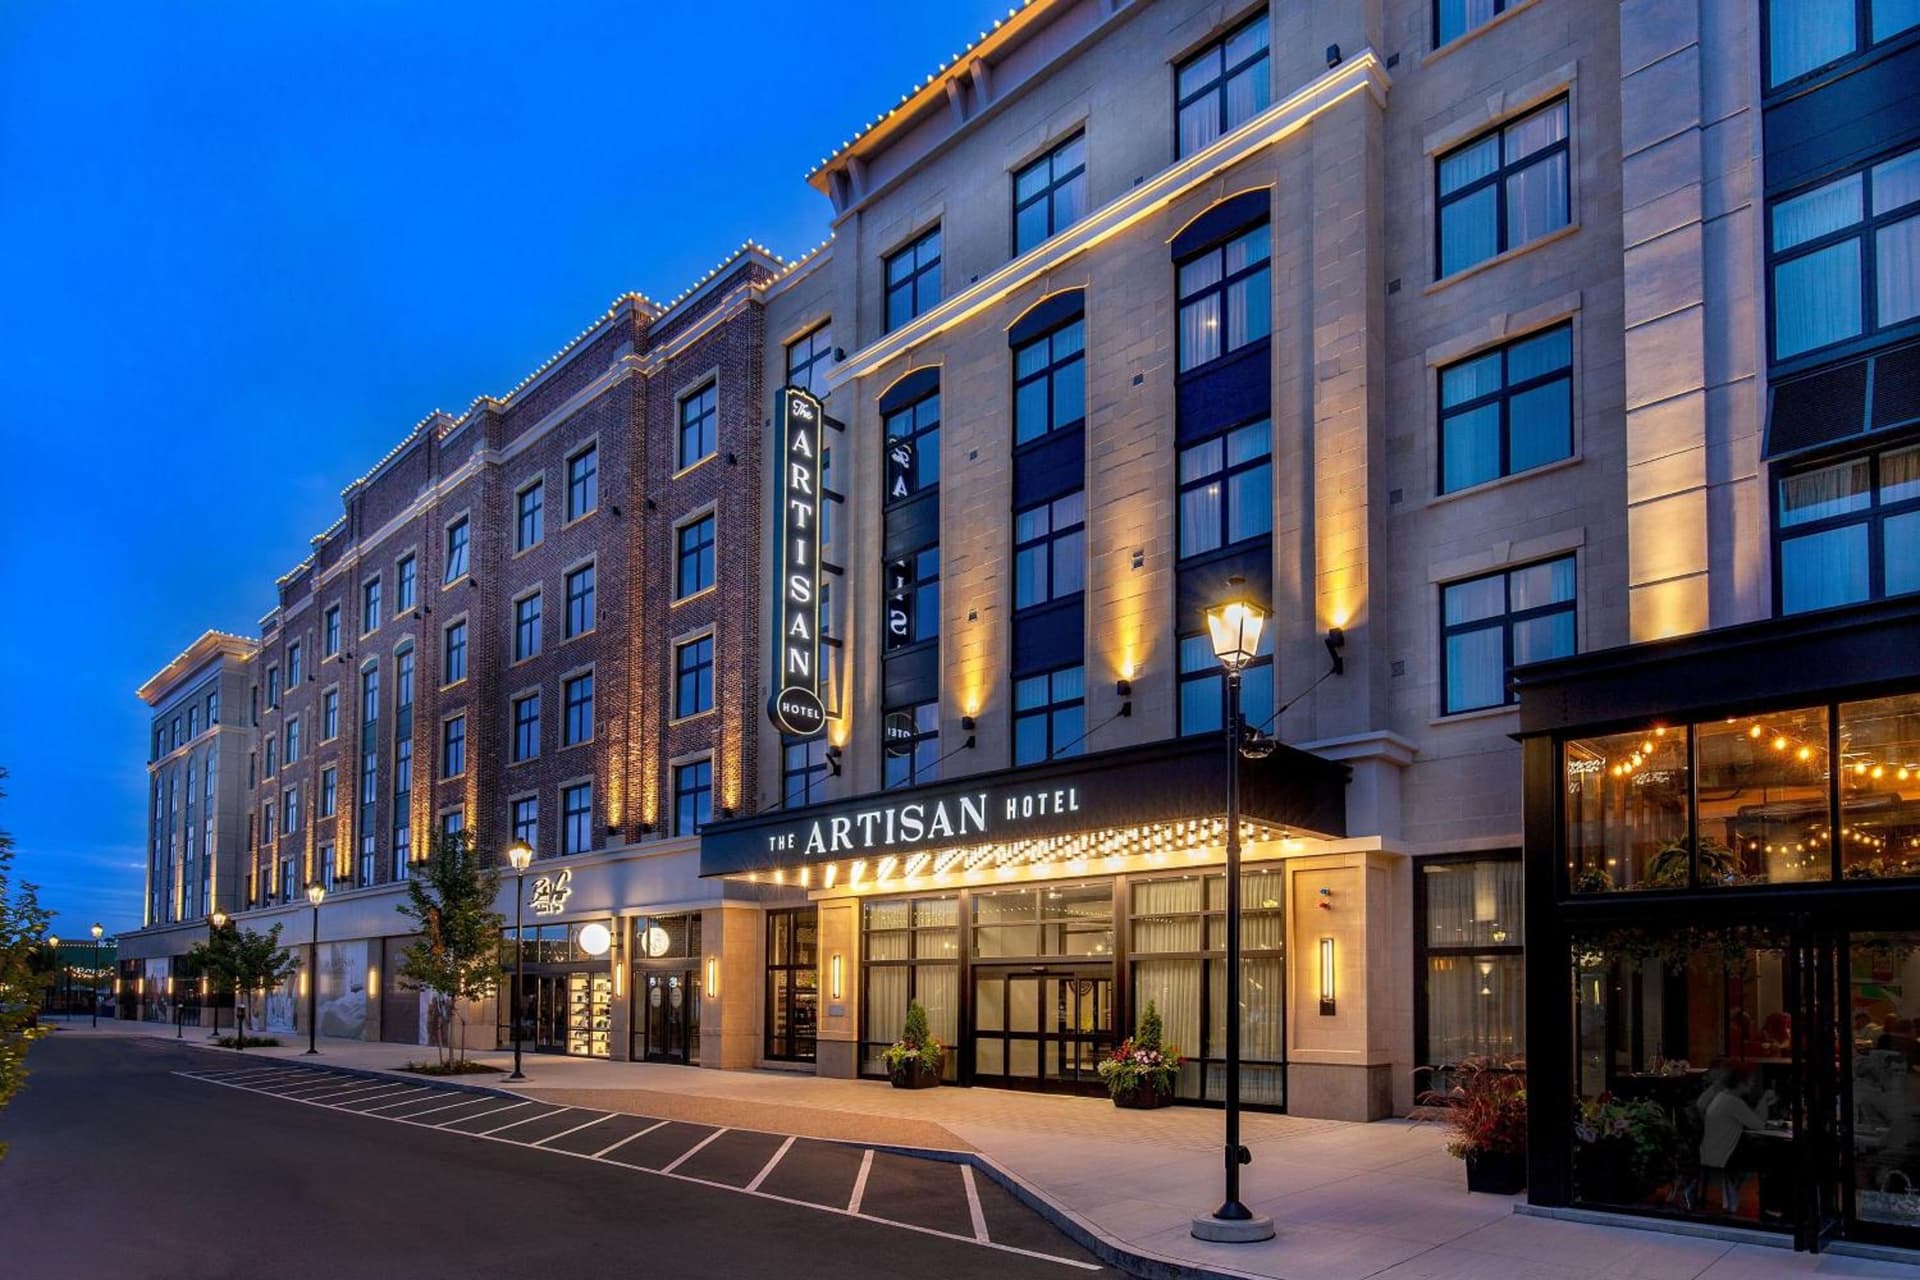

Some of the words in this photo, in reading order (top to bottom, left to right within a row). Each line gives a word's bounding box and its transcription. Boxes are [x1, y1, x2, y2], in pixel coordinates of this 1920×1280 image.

[792, 399, 814, 420] The
[789, 429, 813, 676] ARTISAN
[782, 702, 821, 720] HOTEL
[769, 833, 795, 852] THE
[804, 793, 987, 855] ARTISAN
[1006, 788, 1080, 820] HOTEL
